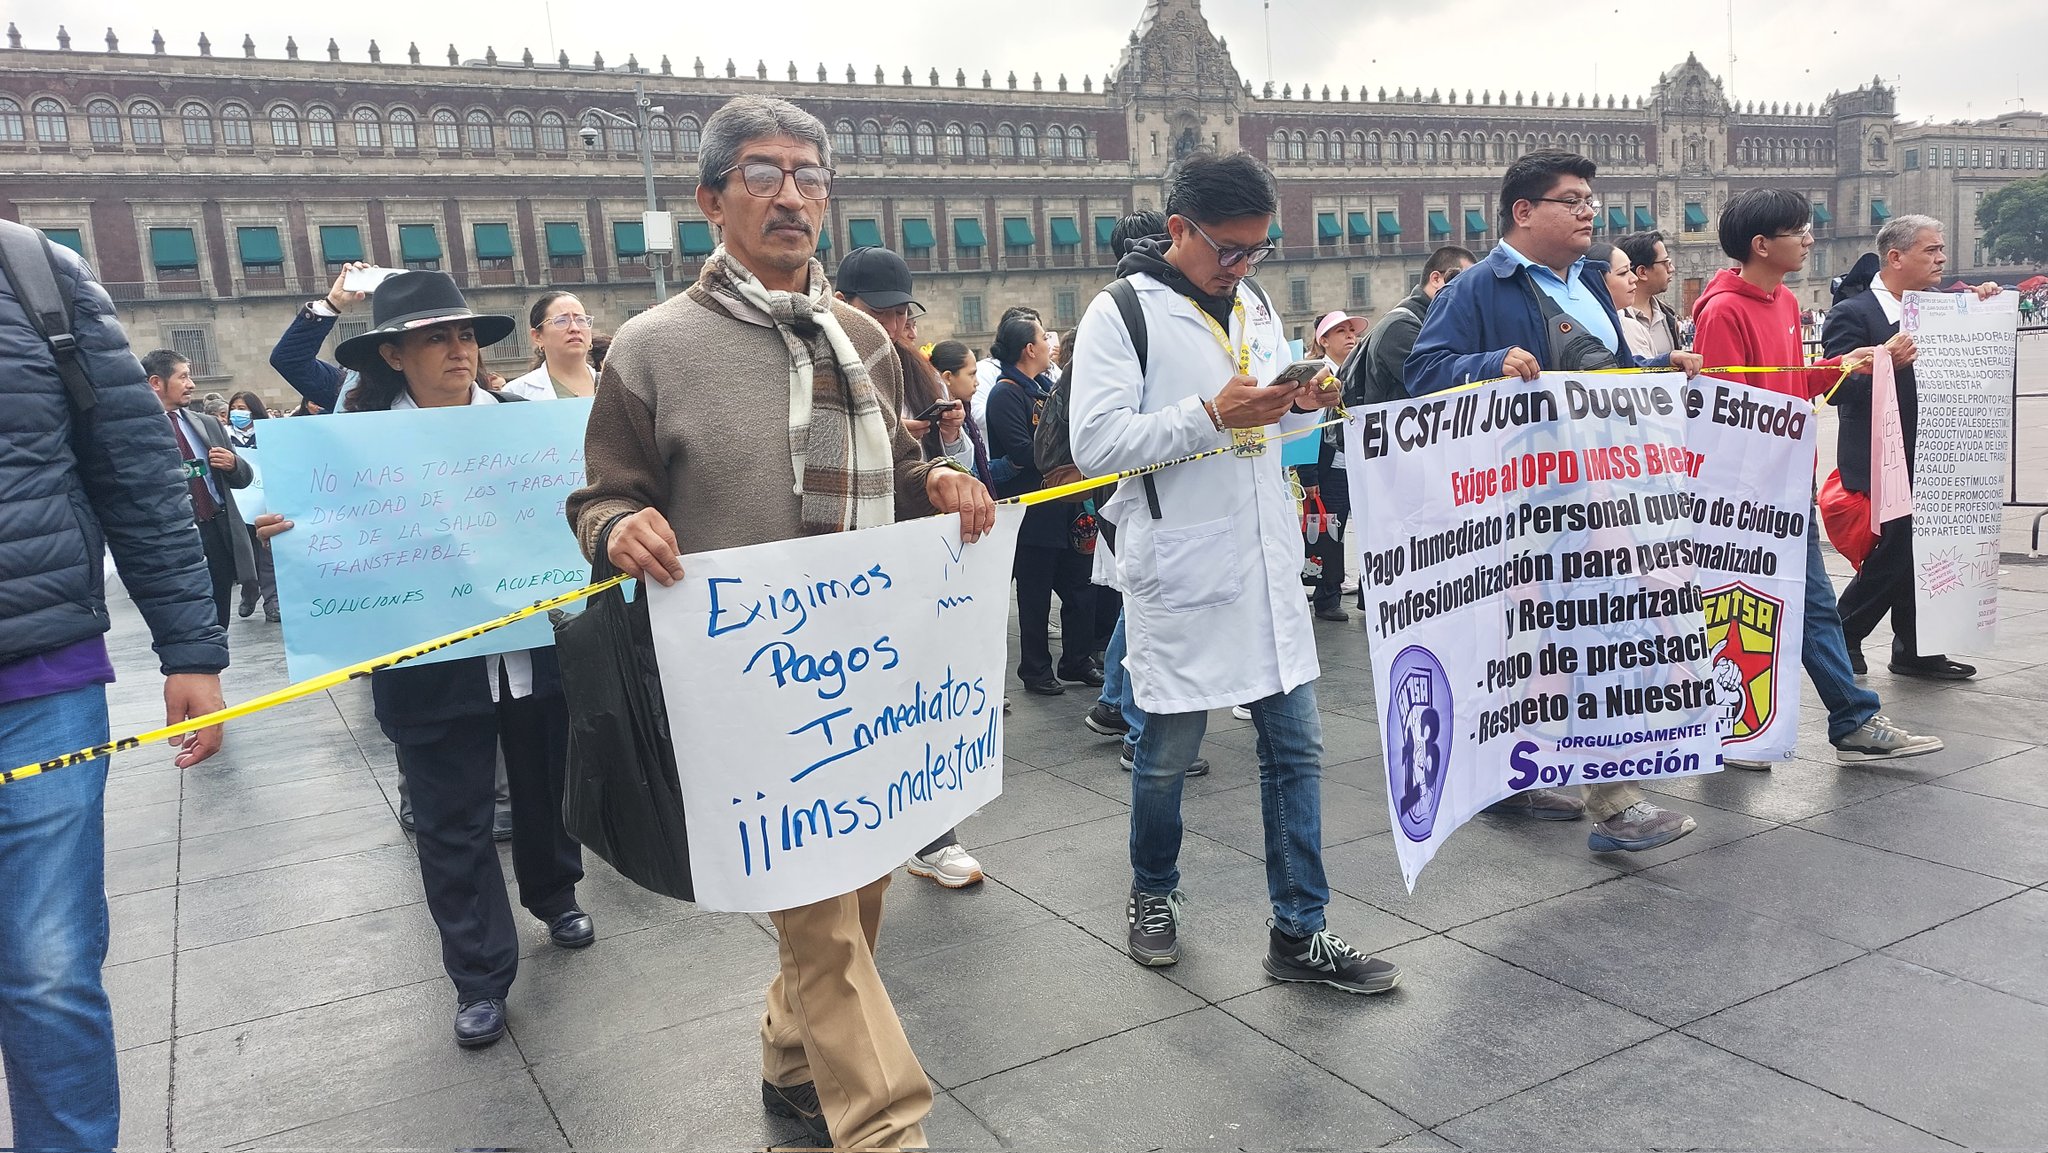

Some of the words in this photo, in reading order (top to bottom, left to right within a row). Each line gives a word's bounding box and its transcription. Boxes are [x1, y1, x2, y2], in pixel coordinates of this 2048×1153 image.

[1937, 332, 2003, 343] TRABAJADORA
[1961, 346, 2007, 356] NUESTROS
[1943, 369, 2004, 379] TRABAJADORES
[1967, 357, 2010, 367] GENERALES
[1917, 393, 1956, 404] EXIGIMOS
[1969, 394, 1997, 404] PRONTO
[1946, 407, 1957, 416] DE
[1958, 407, 1987, 417] EQUIPO
[1363, 410, 1388, 460] El
[1395, 394, 1478, 452] CST-III
[1480, 388, 1558, 433] Juan
[1564, 380, 1673, 425] Duque
[1712, 386, 1806, 440] Estrada
[1917, 429, 1983, 438] PRODUCTIVIDAD
[1945, 418, 1956, 427] DE
[1957, 418, 1982, 427] VALES
[1943, 441, 1955, 450] DE
[1956, 441, 1983, 450] AYUDA
[1986, 441, 1994, 450] DE
[1943, 453, 1958, 462] DEL
[1974, 453, 1988, 462] DEL
[310, 463, 338, 494] NO
[353, 466, 405, 488] MAS
[422, 447, 560, 478] TOLERANCIA,
[1451, 467, 1497, 507] Exige
[1501, 456, 1517, 493] al
[1522, 450, 1579, 489] OPD
[1583, 446, 1641, 482] IMSS
[1915, 464, 1925, 473] LA
[1927, 464, 1956, 473] SALUD
[1941, 477, 1952, 486] DE
[1954, 475, 1997, 486] ESTÍMULOS
[310, 496, 407, 526] DIGNIDAD
[420, 490, 443, 508] DE
[464, 485, 497, 504] LOS
[1941, 491, 1952, 500] DE
[1941, 502, 1952, 512] DE
[307, 533, 343, 557] RES
[358, 528, 382, 546] DE
[397, 522, 423, 542] LA
[435, 511, 498, 533] SALUD
[515, 507, 536, 522] NO
[1410, 515, 1503, 570] Inmediato
[1506, 516, 1516, 542] a
[1519, 493, 1639, 537] Personal
[1710, 497, 1735, 528] de
[1738, 499, 1804, 539] Código
[1912, 515, 1925, 525] NO
[1926, 516, 1932, 525] A
[1933, 513, 1978, 524] VIOLACIÓN
[1979, 514, 1990, 523] DE
[1913, 527, 1930, 536] POR
[1931, 526, 1958, 536] PARTE
[1960, 525, 1975, 535] DEL
[1979, 525, 1995, 534] IMSS
[316, 541, 477, 579] TRANSFERIBLE.
[1562, 543, 1632, 582] para
[309, 587, 426, 619] SOLUCIONES
[451, 582, 474, 598] NO
[496, 568, 585, 592] ACUERDOS
[707, 563, 893, 638] Exigimos
[1506, 608, 1514, 641] y
[1519, 581, 1704, 636] Regularizado
[1539, 643, 1579, 677] de
[1586, 627, 1709, 677] prestaci
[742, 635, 900, 700] Pagos
[1577, 693, 1599, 721] a
[786, 664, 988, 783] Inmediatos
[1556, 723, 1707, 753] ¡ORGULLOSAMENTE!
[1507, 740, 1575, 791] Soy
[1583, 748, 1699, 780] sección
